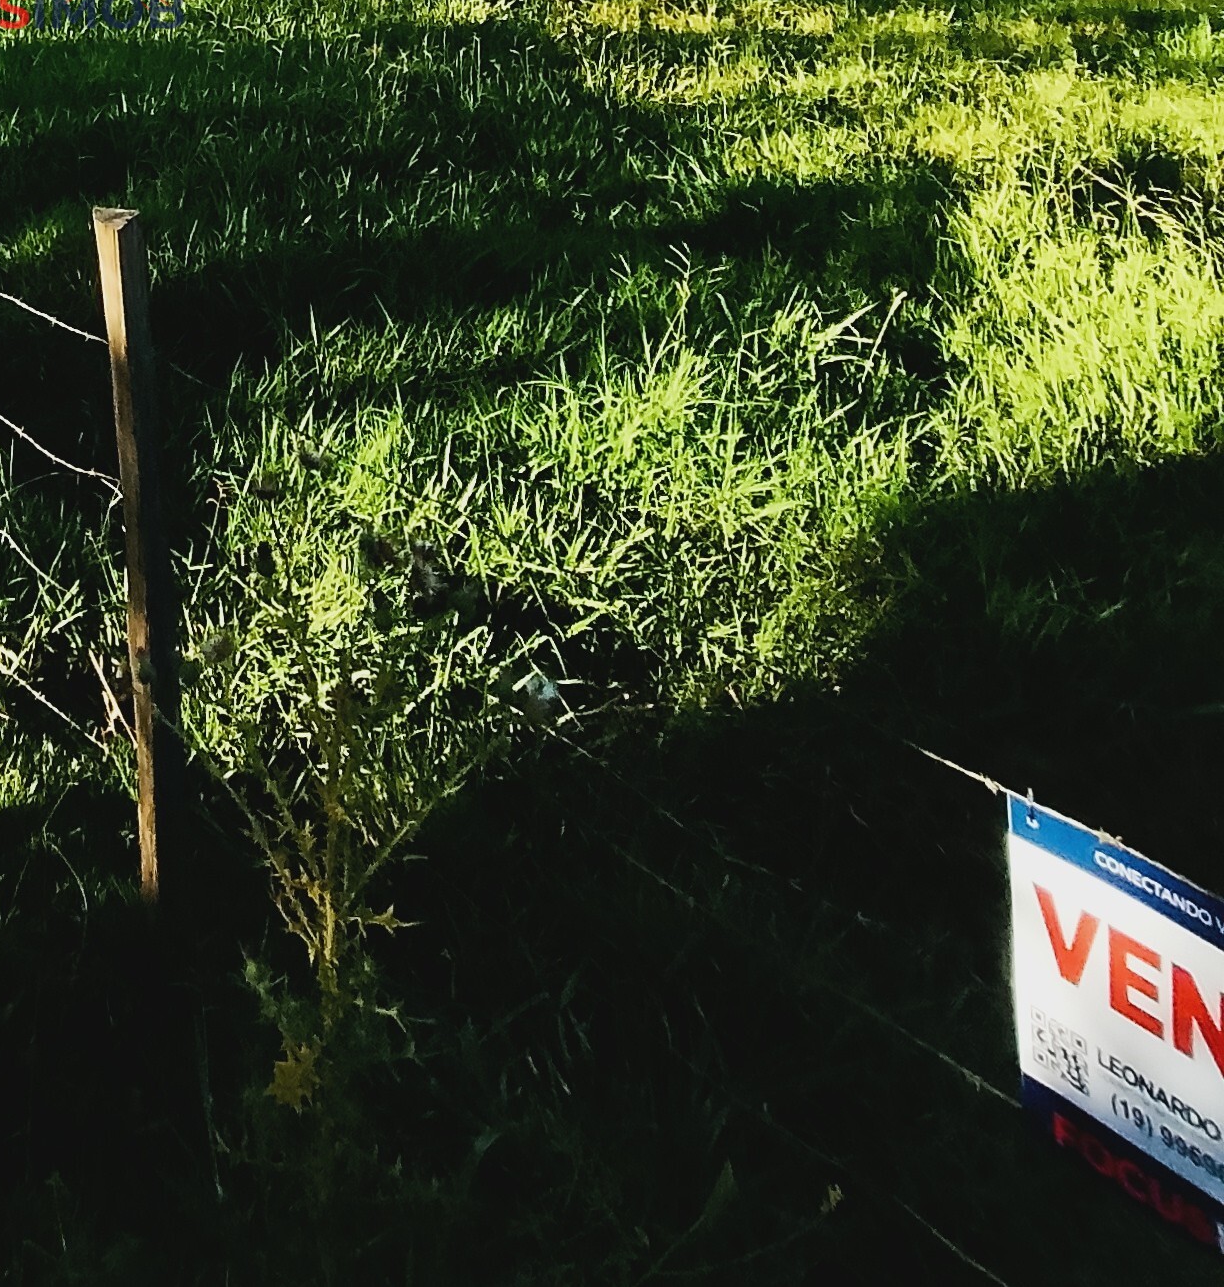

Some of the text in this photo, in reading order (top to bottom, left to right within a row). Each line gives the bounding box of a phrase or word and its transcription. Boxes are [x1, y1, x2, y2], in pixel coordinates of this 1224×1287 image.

[1094, 850, 1213, 925] CONECTANDO
[1033, 881, 1224, 1080] VEN
[1097, 1047, 1222, 1141] LEONARDO
[1111, 1093, 1153, 1137] (19)
